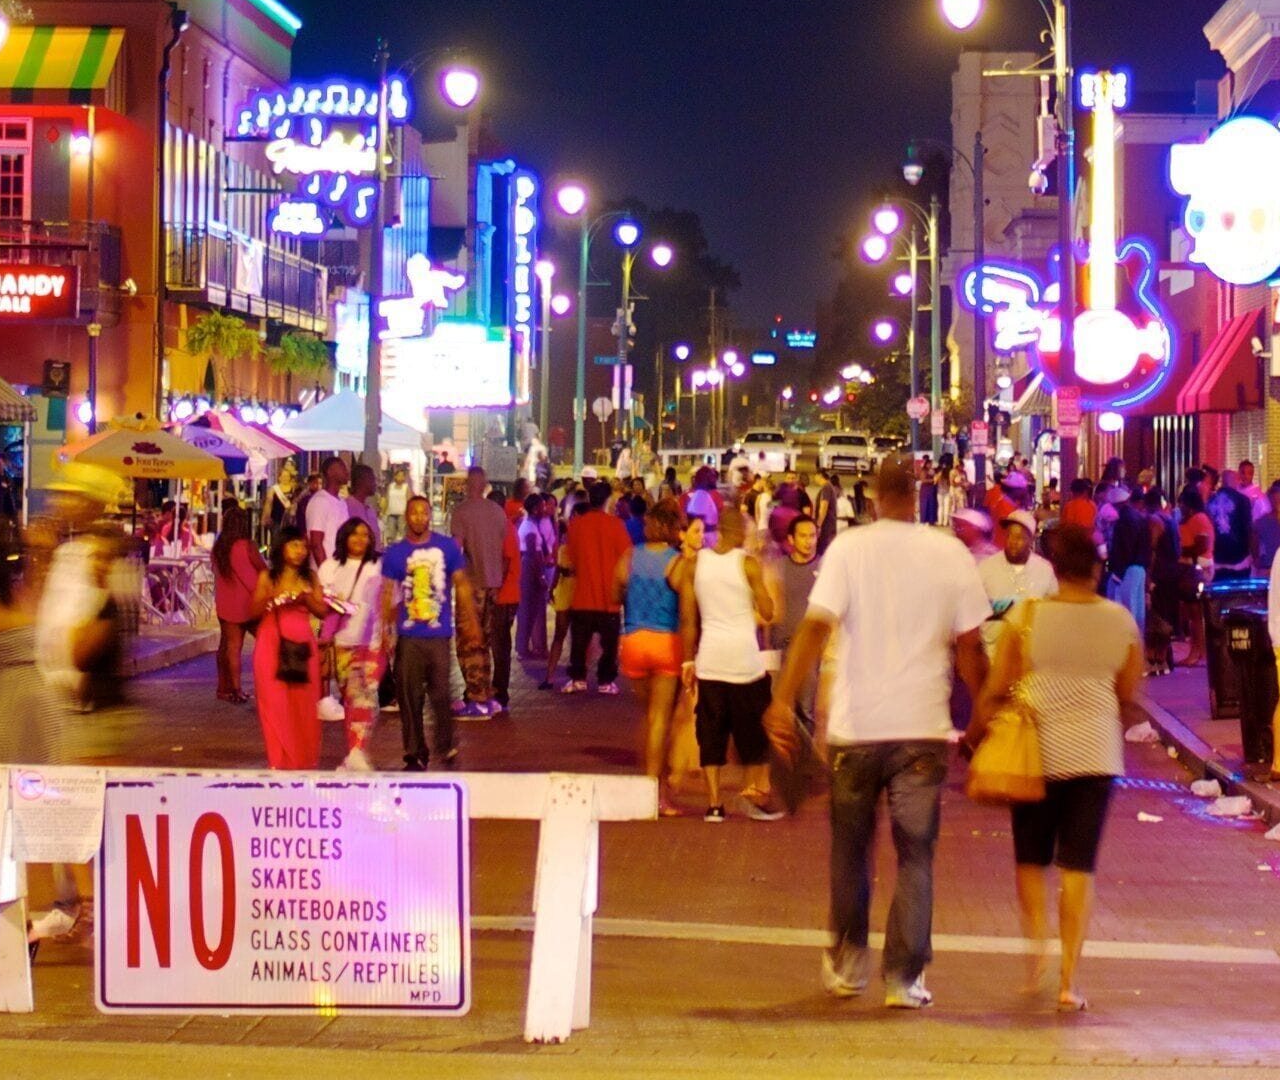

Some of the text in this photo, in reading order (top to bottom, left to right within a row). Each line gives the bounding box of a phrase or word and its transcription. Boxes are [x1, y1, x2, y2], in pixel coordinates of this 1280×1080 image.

[251, 806, 343, 829] VEHICLES
[250, 837, 343, 860] BICYCLES
[251, 868, 322, 890] SKATES
[125, 811, 236, 971] NO
[251, 899, 387, 921] SKATEBOARDS
[250, 930, 439, 954] GLASS CONTAINERS
[251, 961, 440, 985] ANIMALS/REPTILES
[410, 990, 442, 1003] MPD
